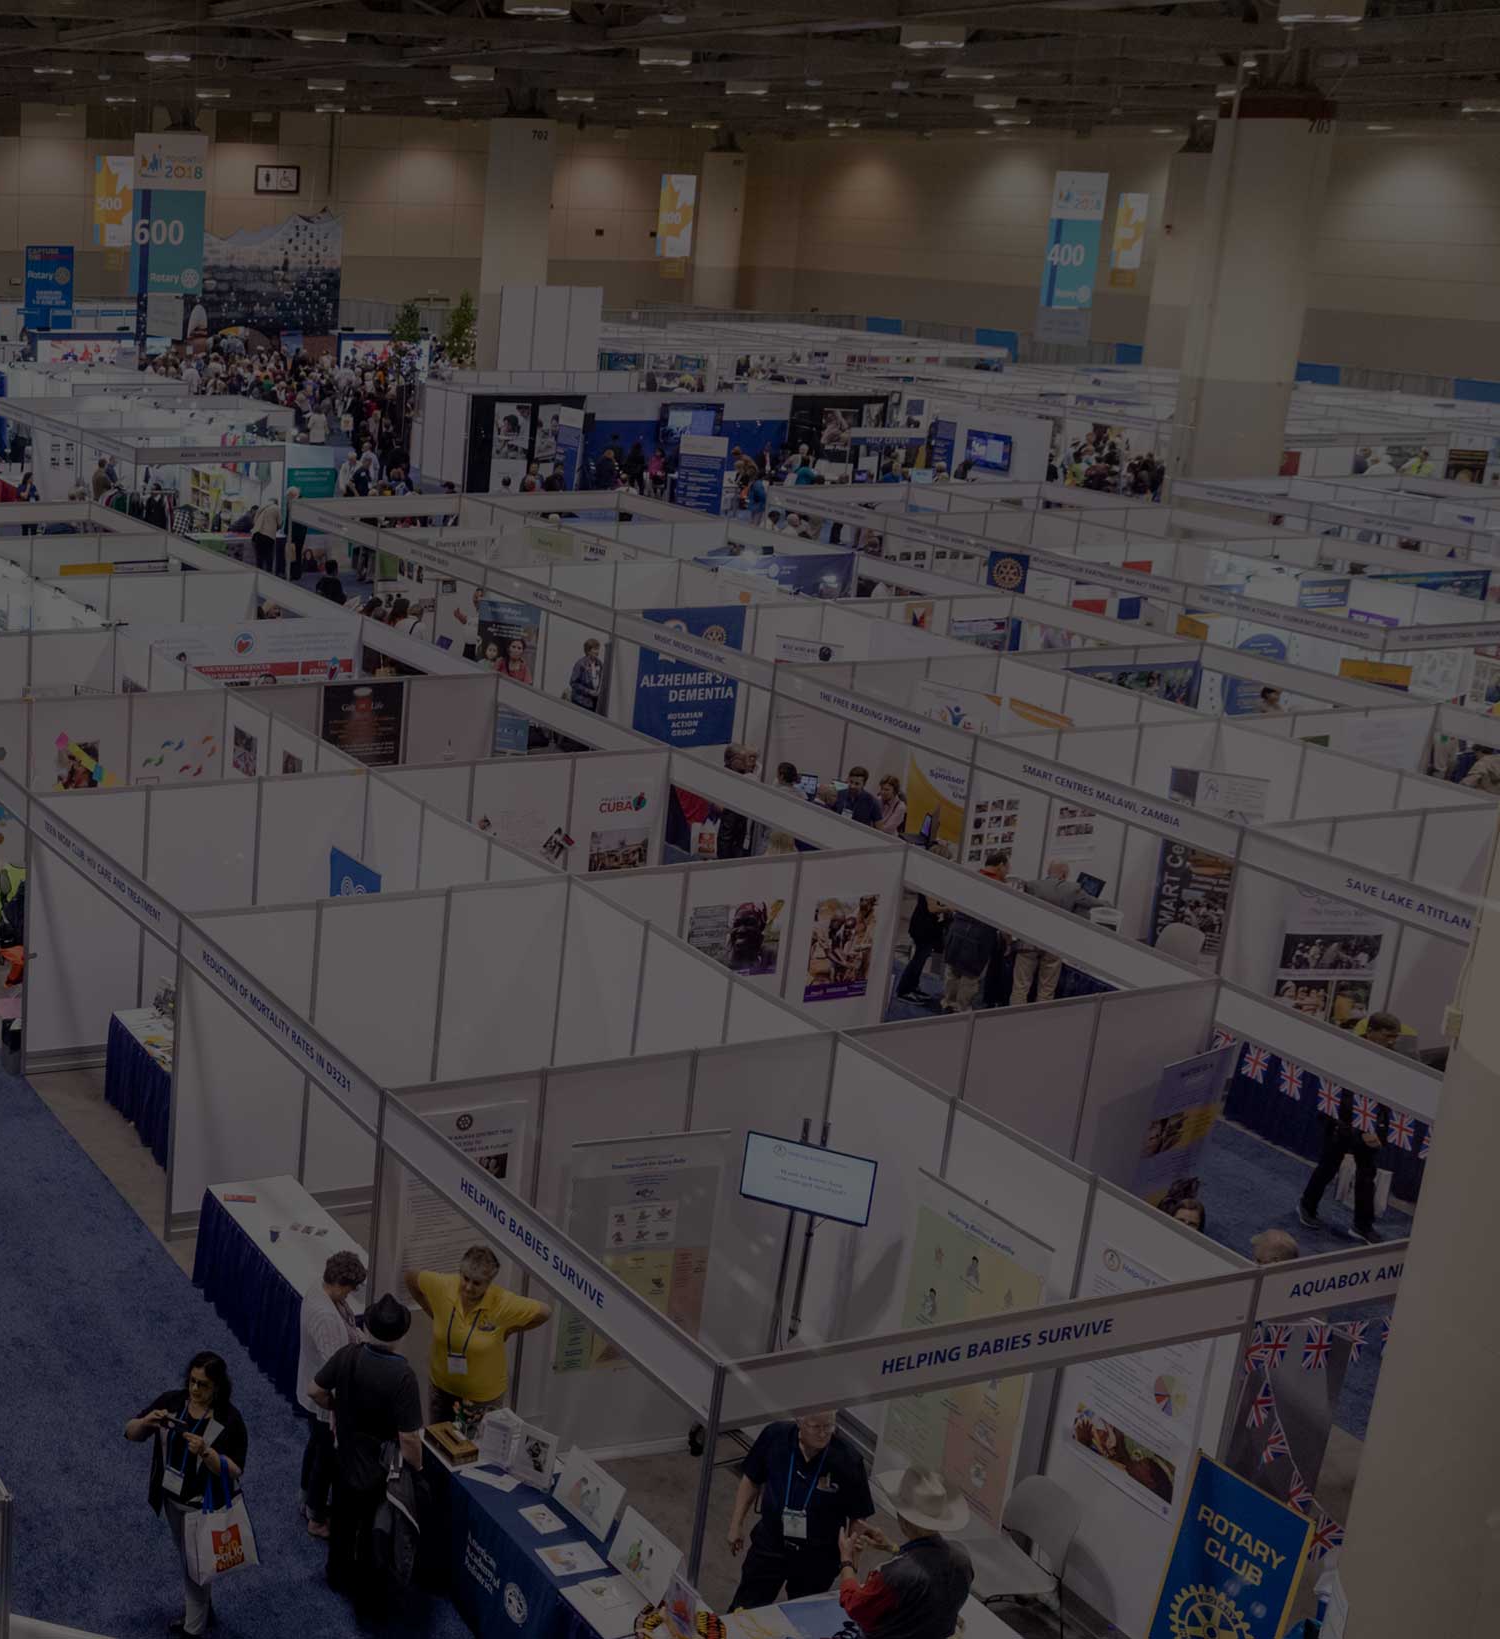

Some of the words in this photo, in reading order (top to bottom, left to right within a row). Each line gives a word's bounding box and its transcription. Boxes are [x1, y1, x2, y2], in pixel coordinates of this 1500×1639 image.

[164, 165, 204, 180] 2018
[97, 197, 122, 210] 500
[134, 219, 185, 245] 600
[1047, 244, 1084, 266] 400
[27, 271, 54, 281] Rotary
[149, 273, 181, 284] Rotary
[668, 686, 734, 703] DEMENTIA
[819, 690, 831, 702] THE
[832, 695, 850, 710] FREE
[851, 702, 882, 723] READING
[883, 715, 921, 736] PROGRAM
[671, 720, 698, 729] ACTION
[671, 729, 696, 737] GROUP
[929, 768, 965, 786] Sponsor
[1022, 763, 1052, 781] SMART
[1054, 774, 1093, 798] CENTRES
[1140, 804, 1180, 828] ZAMBIA
[600, 801, 633, 813] CUBA
[97, 863, 112, 884] CARE
[113, 876, 126, 894] AND
[127, 886, 161, 922] TREATMENT
[1345, 878, 1379, 898] SAVE
[1381, 888, 1414, 911] LAKE
[1415, 901, 1472, 930] ATITLAN
[203, 951, 238, 991] REDUCTION
[239, 984, 249, 1000] OF
[249, 992, 290, 1036] MORTALITY
[291, 1030, 314, 1060] RATES
[315, 1053, 324, 1069] IN
[326, 1061, 351, 1092] D3231
[460, 1177, 506, 1225] HELPING
[508, 1217, 550, 1262] BABIES
[552, 1255, 605, 1309] SURVIVE
[1290, 1269, 1370, 1298] AQUABOX
[881, 1346, 961, 1375] HELPING
[966, 1333, 1032, 1360] BABIES
[1037, 1318, 1114, 1346] SURVIVE
[219, 1540, 238, 1554] END
[1198, 1504, 1286, 1569] ROTARY
[215, 1546, 244, 1561] POLIO
[1205, 1537, 1263, 1586] CLUB
